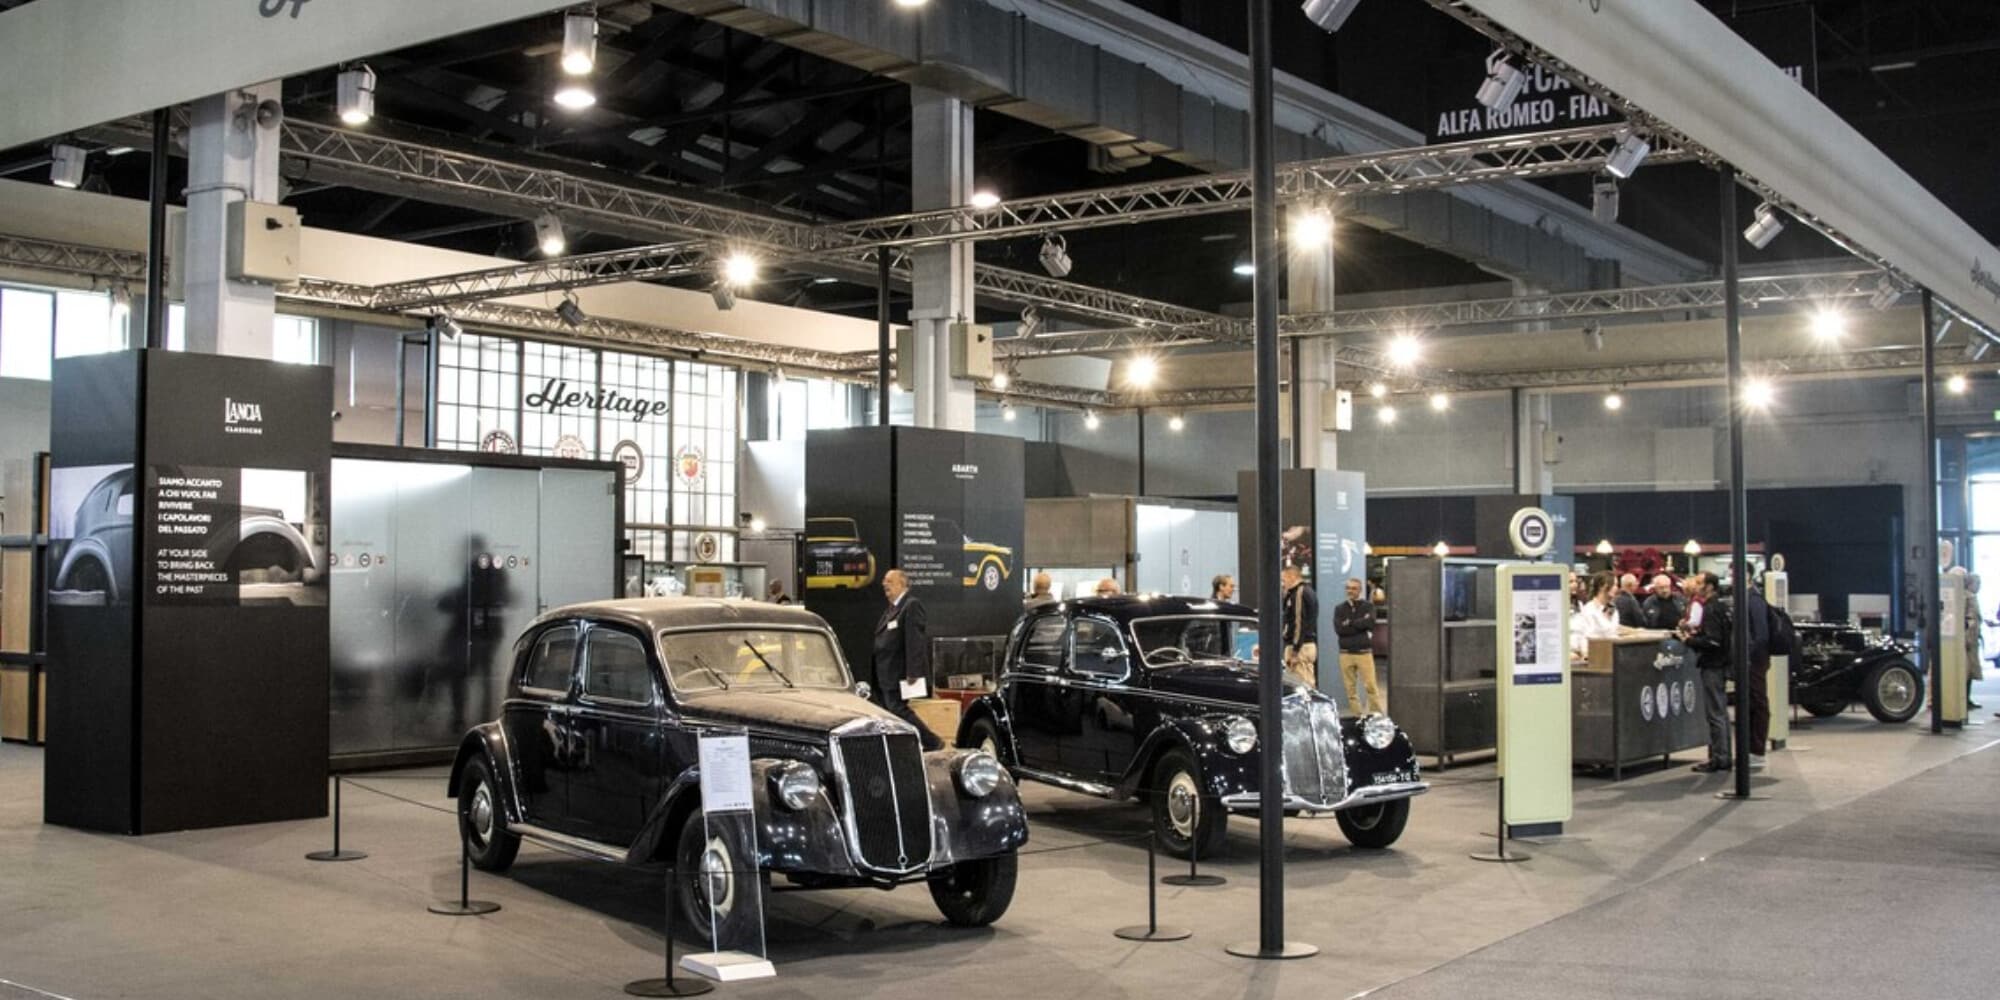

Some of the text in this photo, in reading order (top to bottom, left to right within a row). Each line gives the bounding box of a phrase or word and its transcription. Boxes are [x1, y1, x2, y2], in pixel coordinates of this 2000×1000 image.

[1437, 109, 1482, 137] ALFA
[1486, 99, 1554, 131] ROMEO
[1570, 95, 1609, 120] FIAT
[526, 378, 669, 423] Heritage
[225, 398, 262, 423] LANCIA
[952, 464, 978, 473] ABARTH
[158, 478, 223, 488] SIAMO ACCANTO
[158, 489, 217, 500] A CHI VUOL FAR
[158, 501, 193, 511] RIVIVERE
[163, 514, 212, 523] CAPOLAVORI
[158, 525, 208, 535] DEL PASSATO
[157, 549, 207, 559] AT YOUR SIDE
[157, 560, 214, 570] TO BRING BACK
[157, 572, 228, 582] THE MASTERPIECES
[156, 584, 204, 594] OF THE PAST
